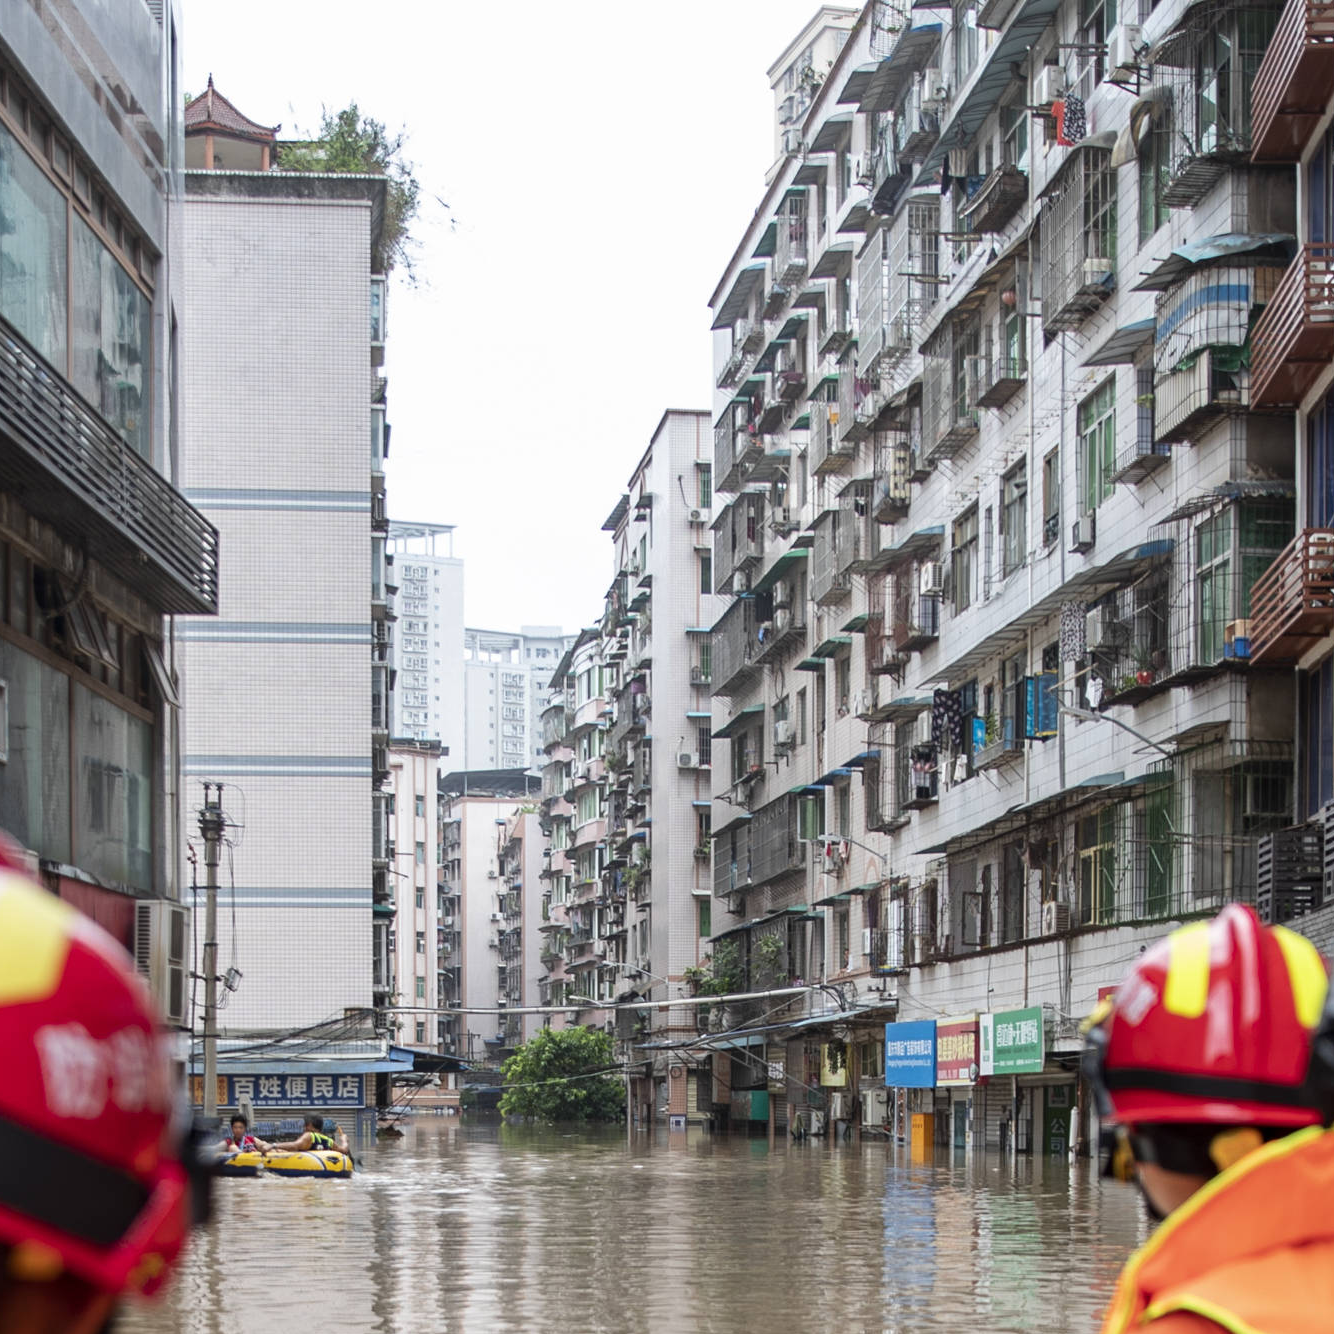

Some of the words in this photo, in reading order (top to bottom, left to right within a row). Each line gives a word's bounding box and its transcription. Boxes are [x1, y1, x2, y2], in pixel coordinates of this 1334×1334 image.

[233, 1075, 360, 1099] 百姓便民店
